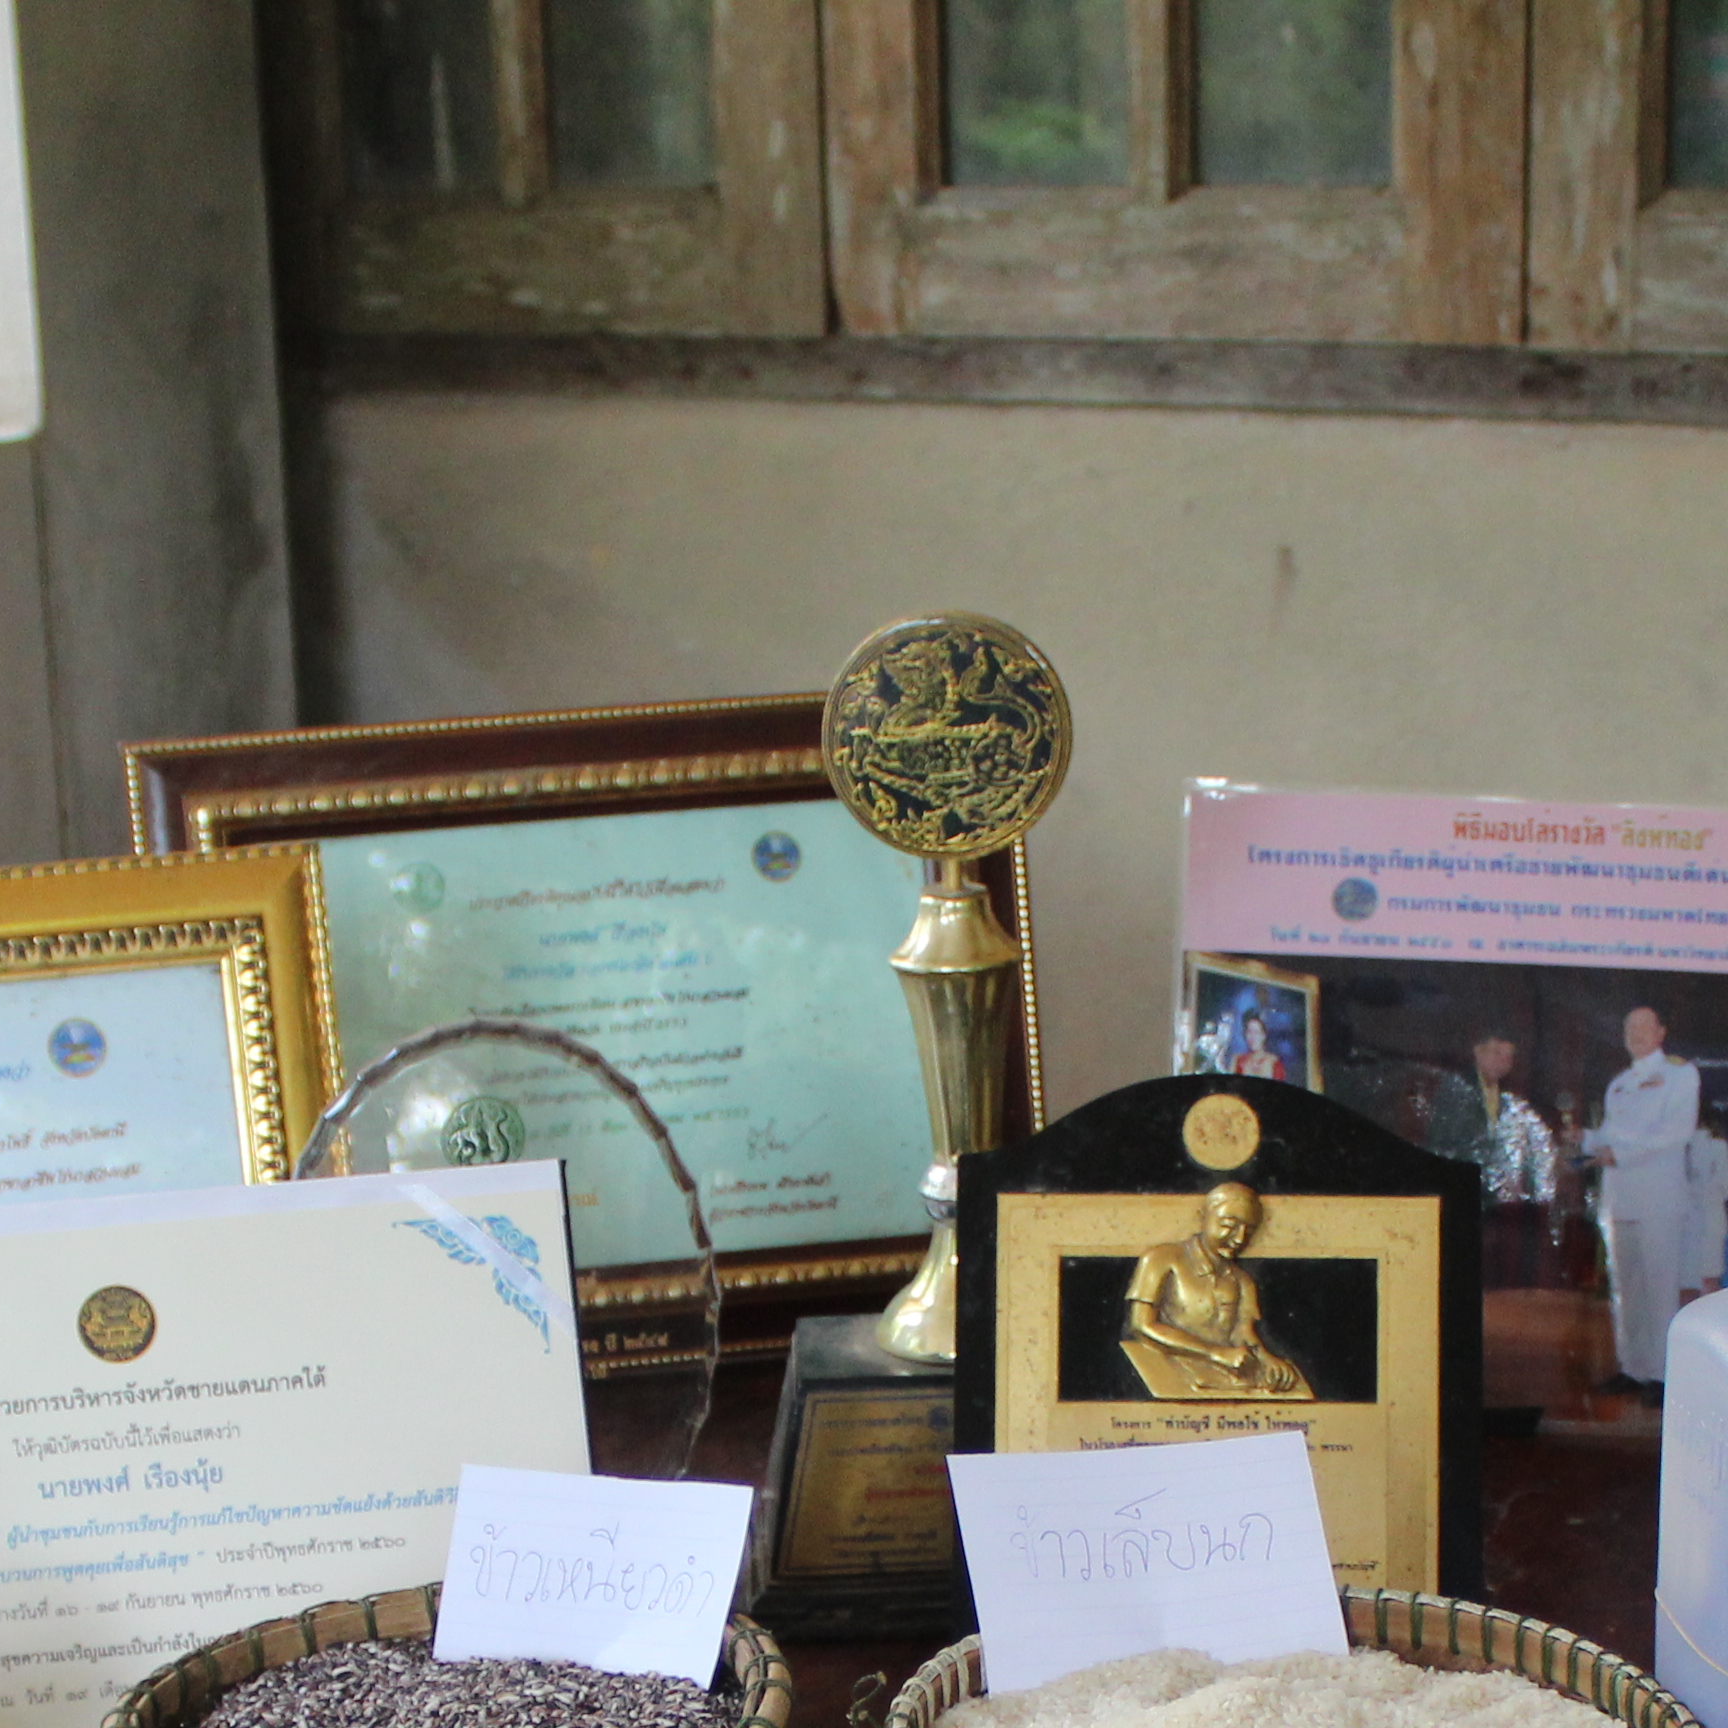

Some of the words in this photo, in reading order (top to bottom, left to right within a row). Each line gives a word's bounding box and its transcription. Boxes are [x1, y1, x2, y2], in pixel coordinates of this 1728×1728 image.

[38, 1465, 131, 1500] นายพงศ์
[143, 1458, 223, 1493] เรืองนุ้ย
[469, 1521, 715, 1617] ข้าวเหนียวดำ
[125, 1592, 186, 1612] กันยายน
[192, 1583, 270, 1609] พุทธศักราช
